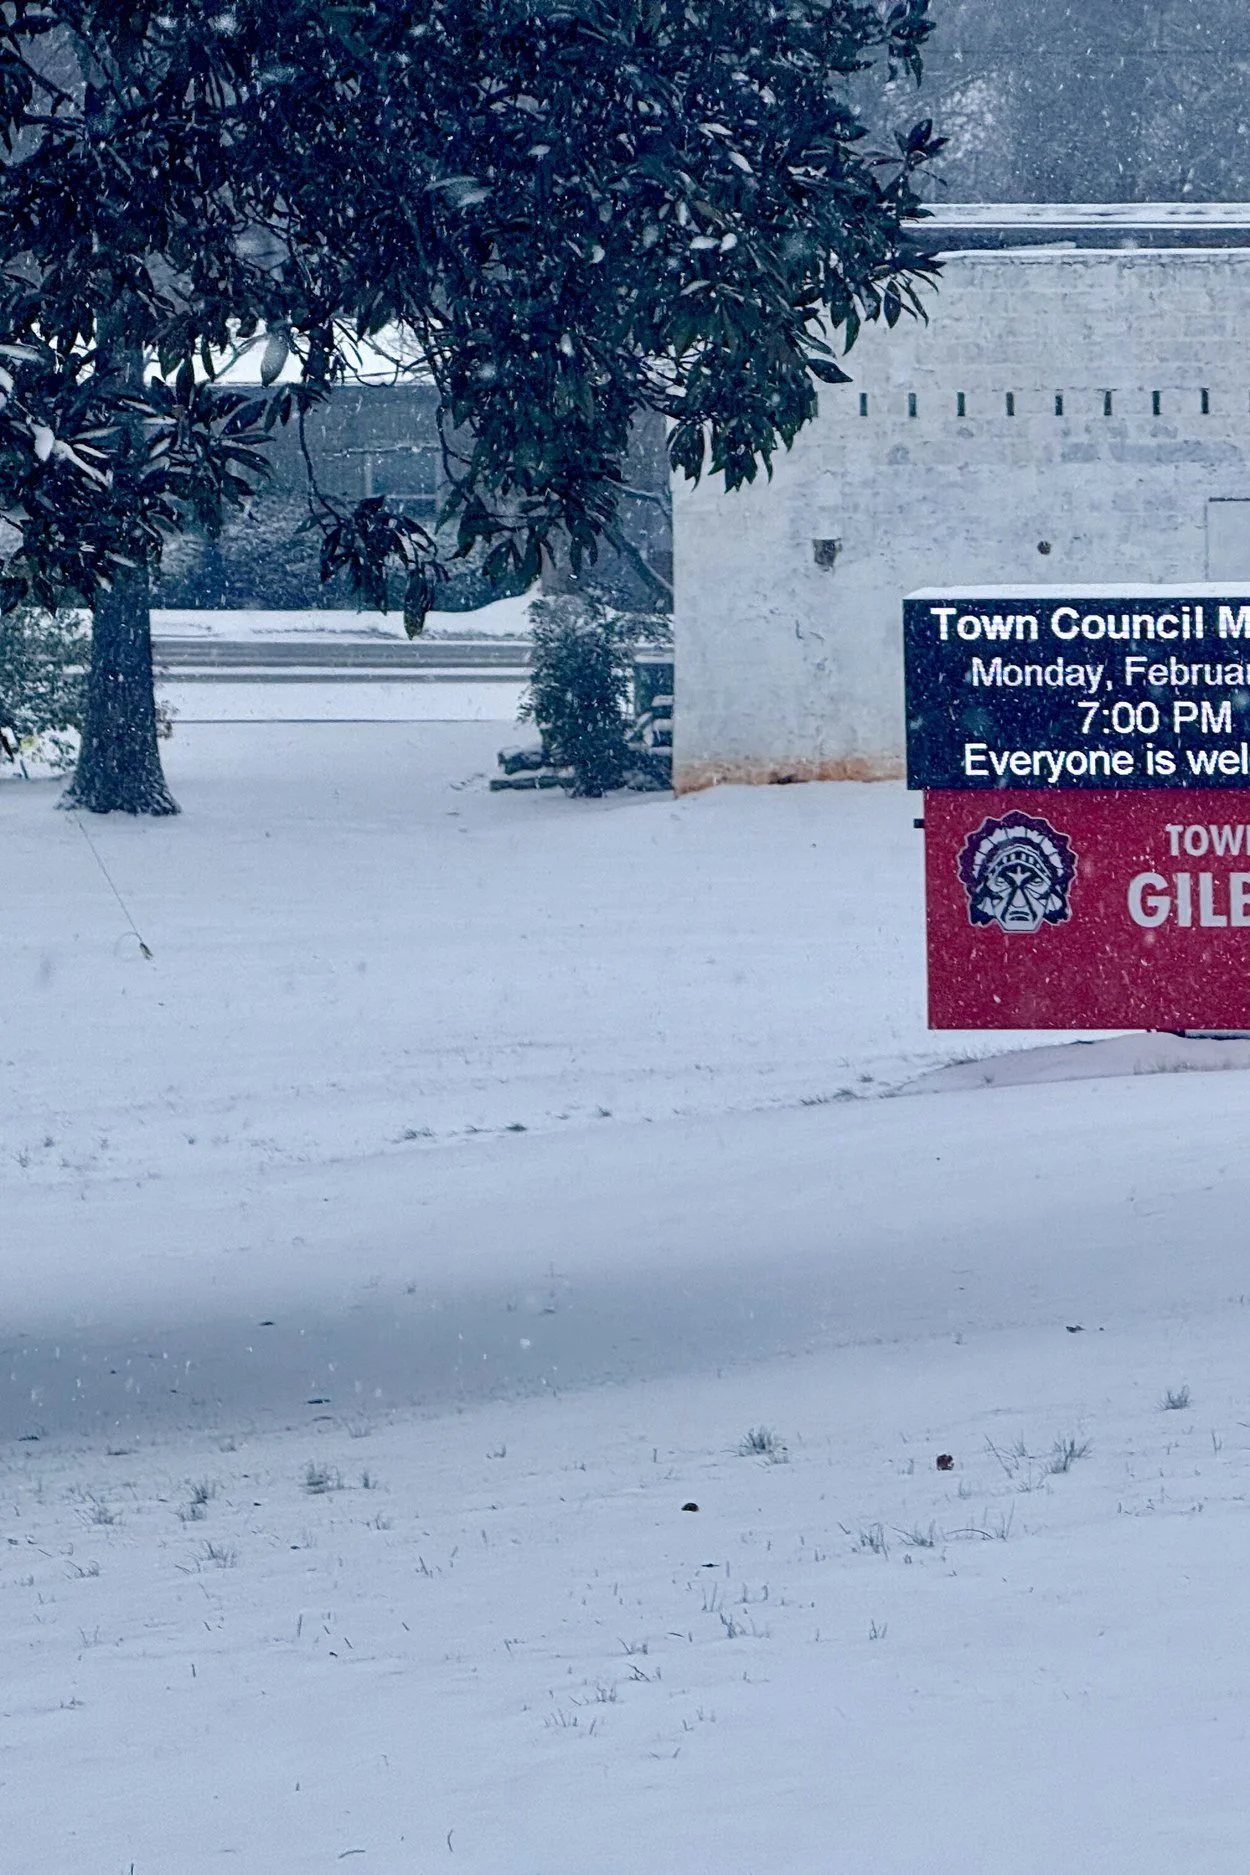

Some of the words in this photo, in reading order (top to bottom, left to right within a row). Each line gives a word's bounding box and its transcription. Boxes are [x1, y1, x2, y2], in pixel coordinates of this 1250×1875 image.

[931, 607, 1038, 640] Town
[1051, 606, 1204, 640] Council
[972, 659, 1113, 690] Monday,
[1078, 701, 1159, 734] 7:00
[1174, 701, 1232, 733] PM
[965, 744, 1134, 782] Everyone
[1146, 745, 1176, 775] is
